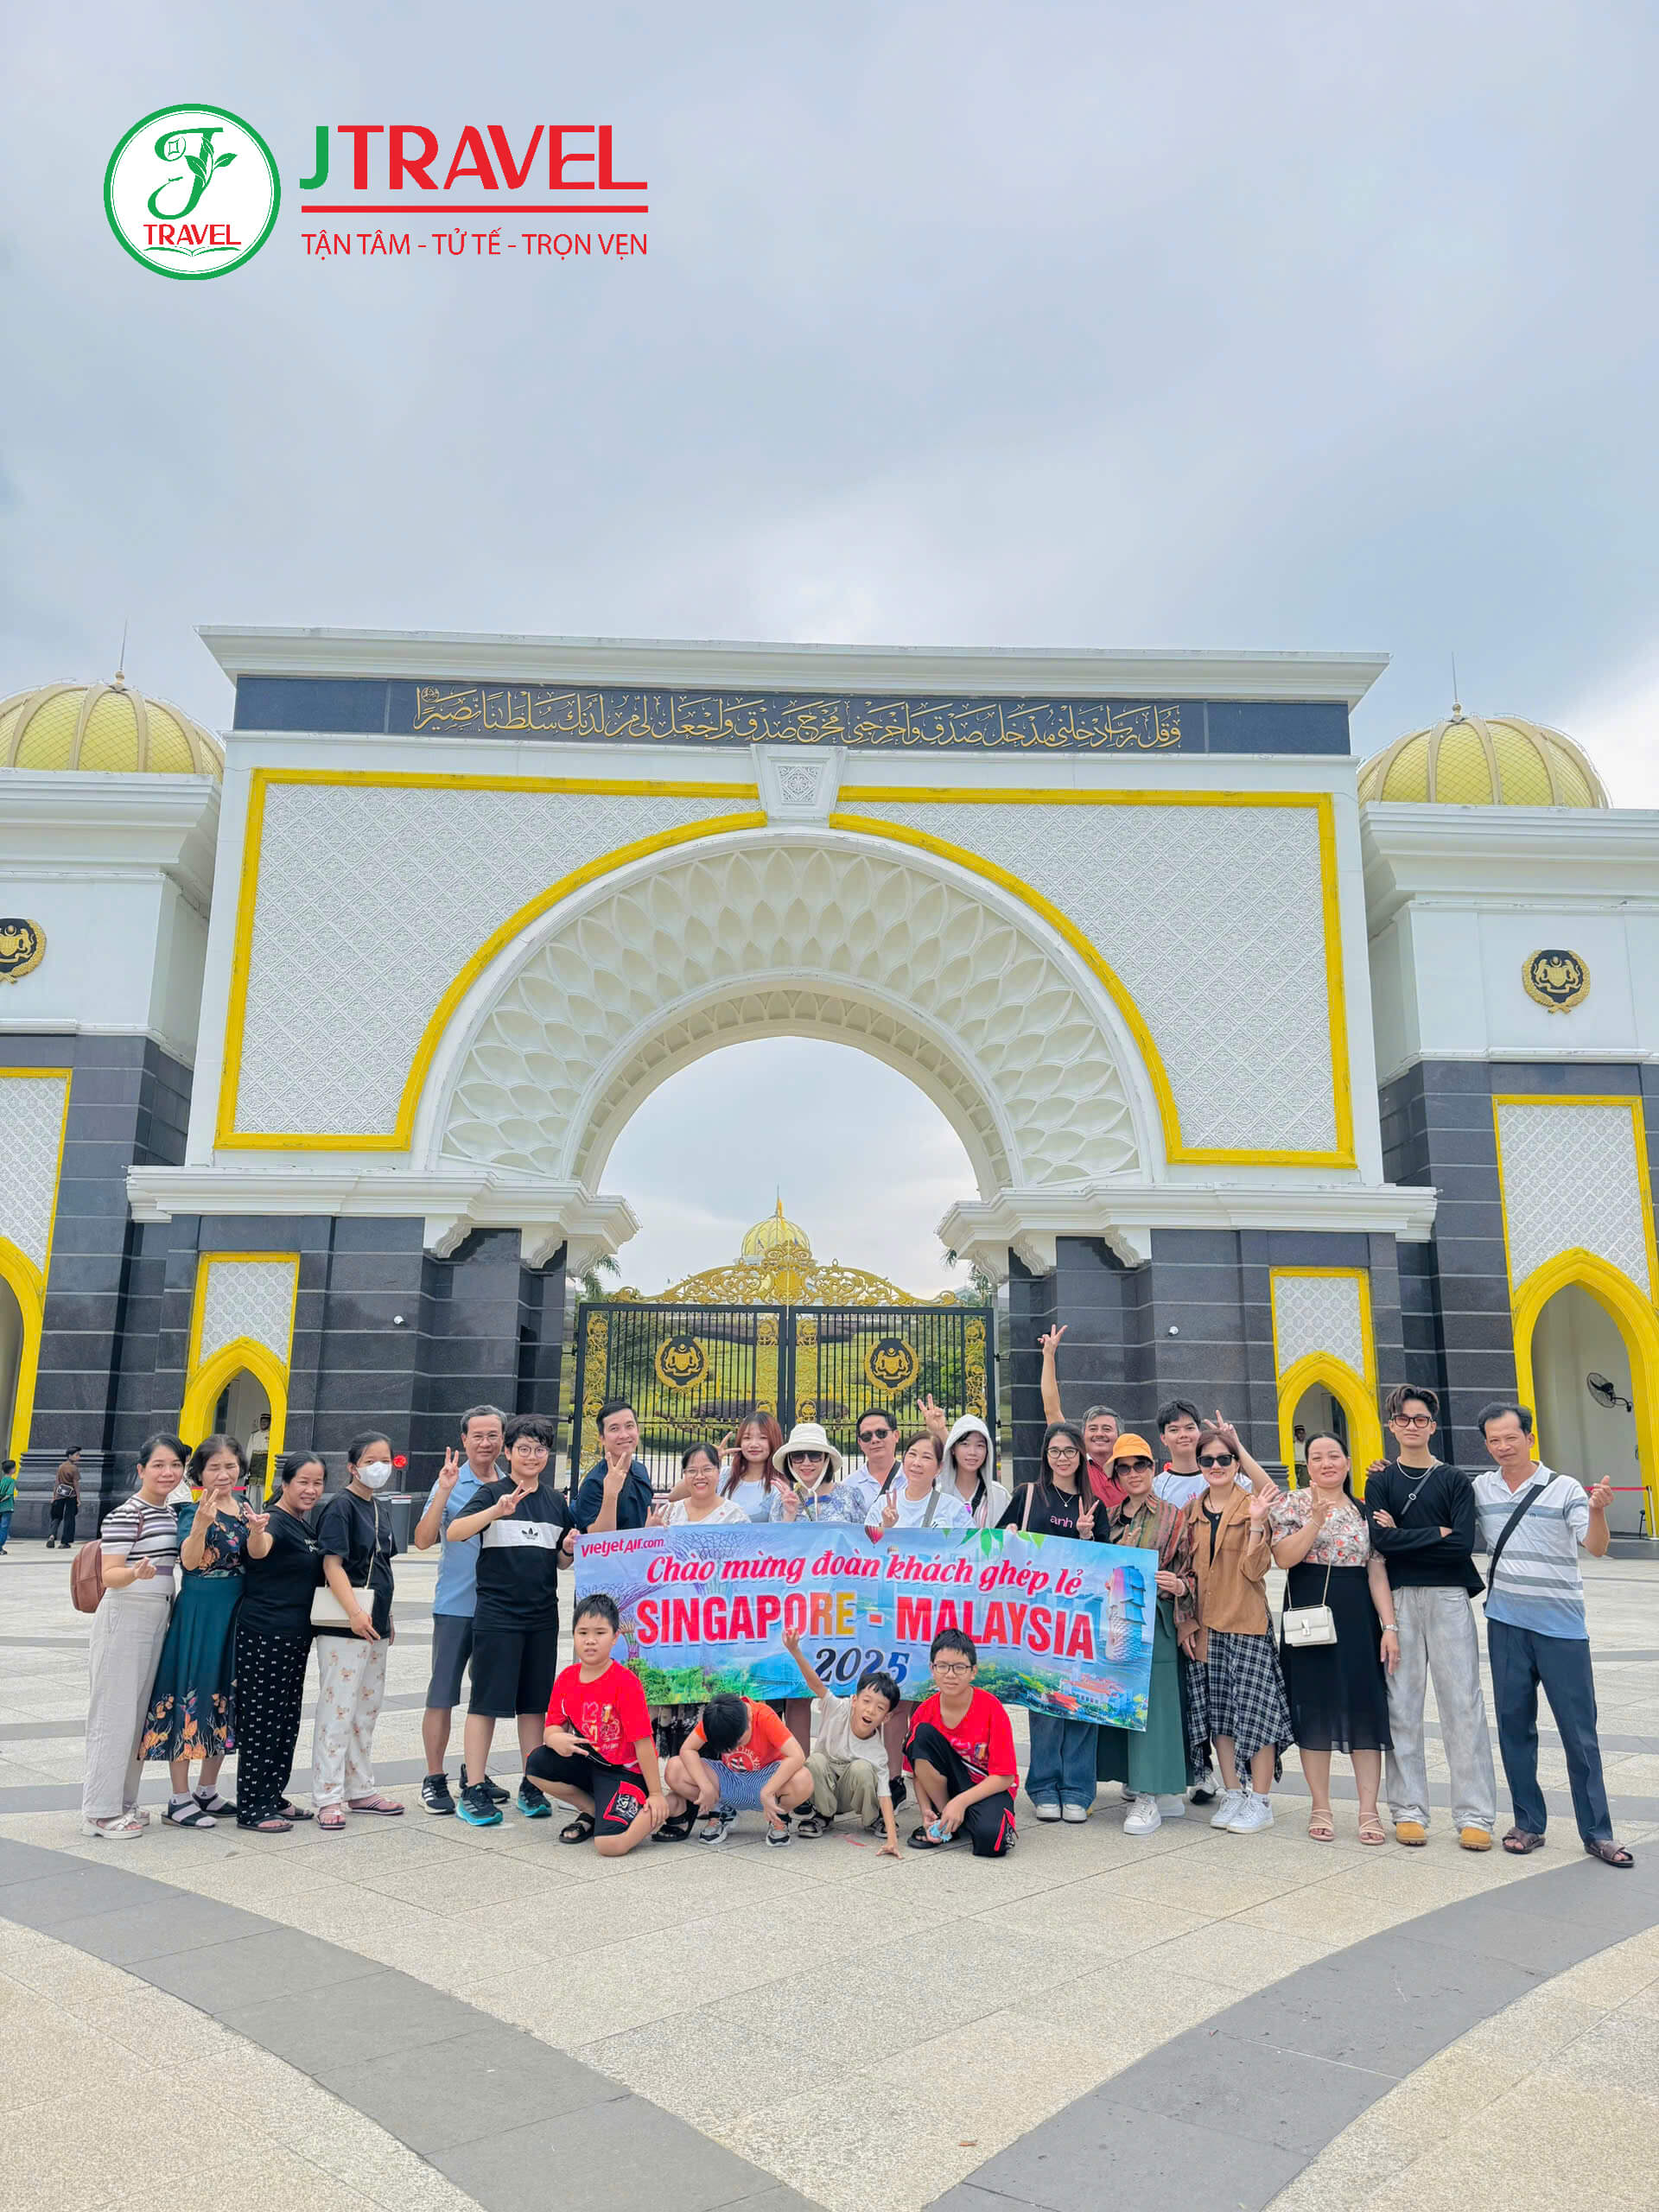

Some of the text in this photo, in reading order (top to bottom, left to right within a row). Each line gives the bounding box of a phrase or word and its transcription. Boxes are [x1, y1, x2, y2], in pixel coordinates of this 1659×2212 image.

[646, 1548, 1084, 1597] Chào mừng đoàn khách ghép lẻ
[636, 1592, 855, 1645] SINGAPORE
[895, 1596, 1094, 1660] MALAYSIA
[815, 1647, 911, 1685] 2025
